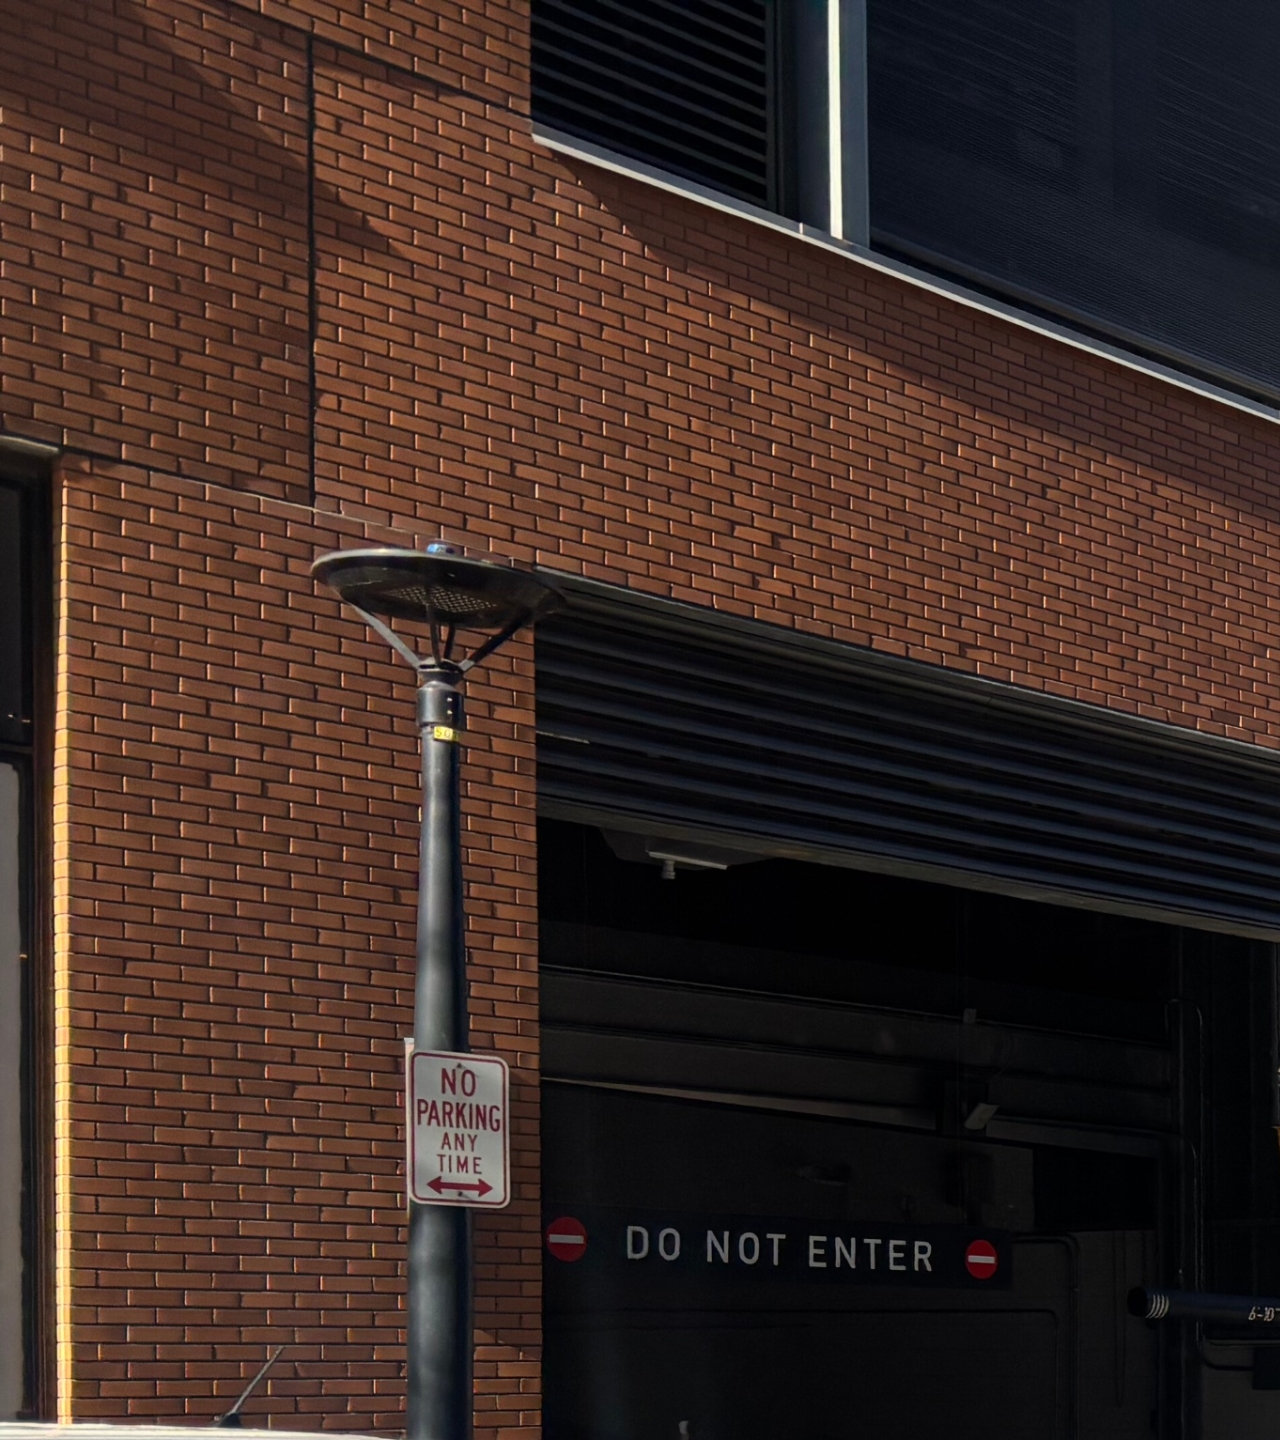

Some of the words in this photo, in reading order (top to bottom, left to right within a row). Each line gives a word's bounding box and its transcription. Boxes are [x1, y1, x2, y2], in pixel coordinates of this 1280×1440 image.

[441, 1068, 476, 1097] NO
[417, 1098, 500, 1132] PARKING
[441, 1131, 478, 1152] ANY
[437, 1154, 482, 1174] TIME
[626, 1225, 681, 1261] DO
[706, 1229, 787, 1267] NOT
[808, 1235, 933, 1272] ENTER
